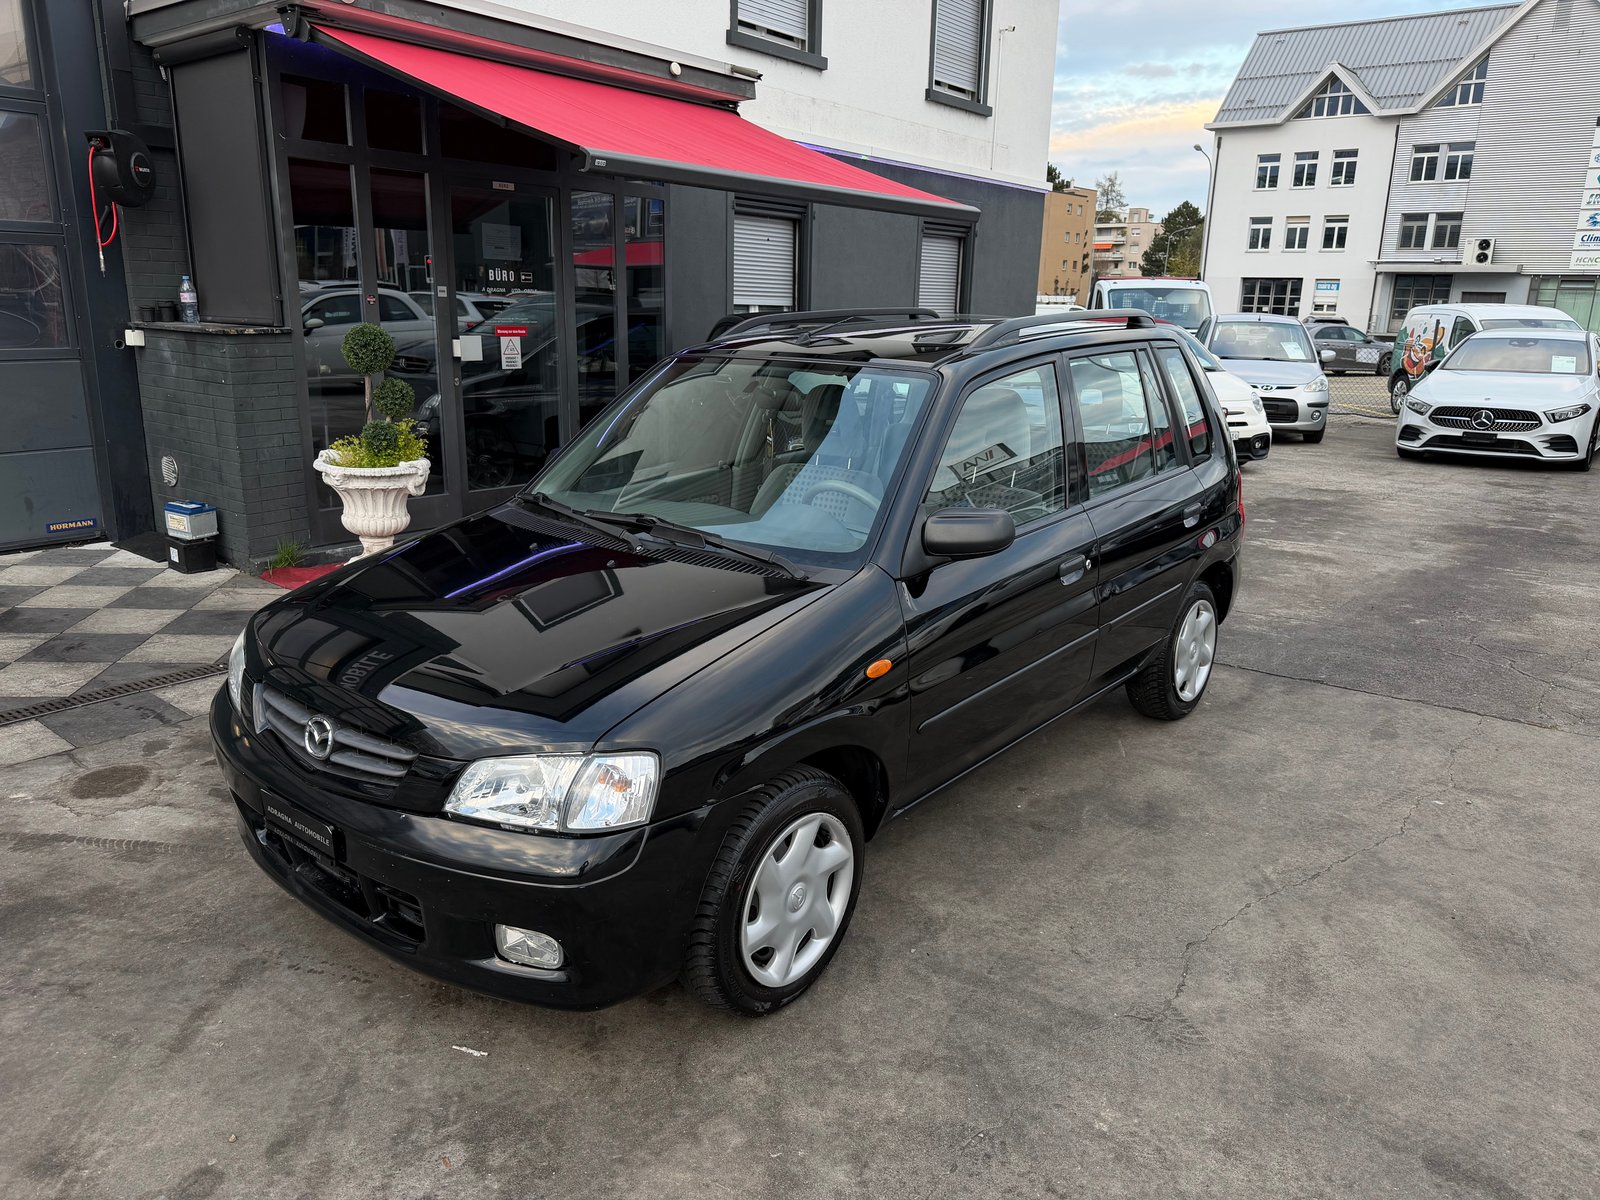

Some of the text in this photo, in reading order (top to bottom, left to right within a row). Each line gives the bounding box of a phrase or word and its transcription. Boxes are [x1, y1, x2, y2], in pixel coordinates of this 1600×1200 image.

[488, 267, 515, 282] BÜRO
[267, 805, 330, 847] ADRAGNA AUTOMOBILE
